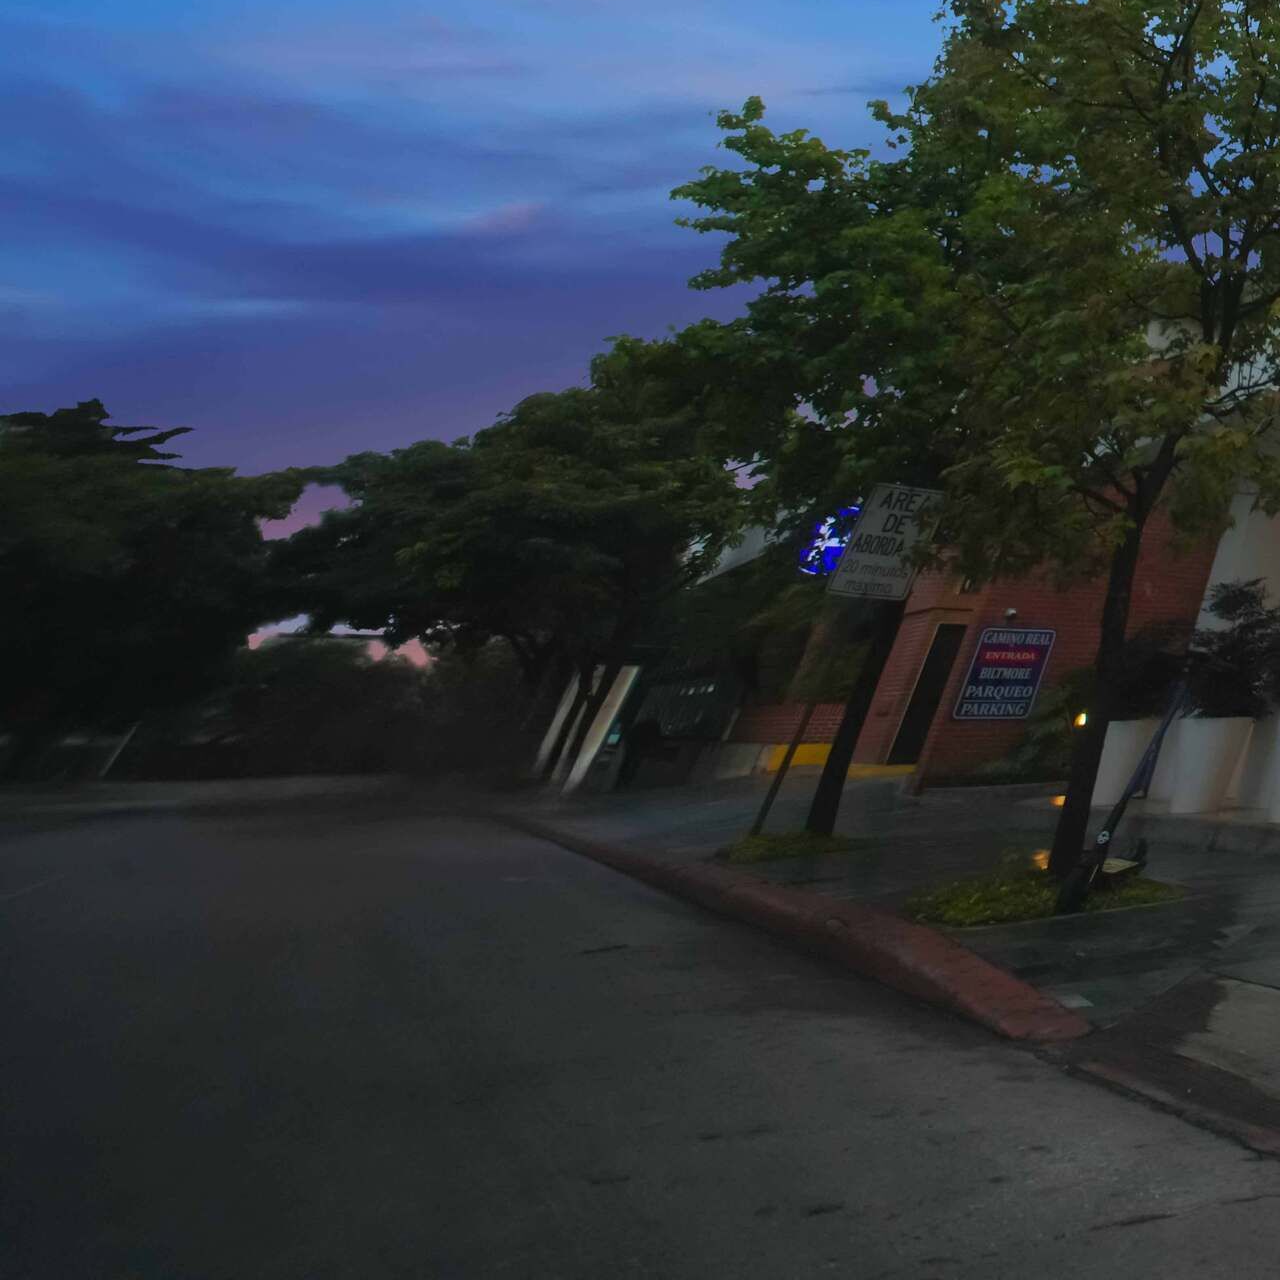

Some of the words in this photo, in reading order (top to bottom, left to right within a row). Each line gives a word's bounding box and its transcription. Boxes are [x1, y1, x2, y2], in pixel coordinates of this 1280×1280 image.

[882, 513, 912, 534] DE
[851, 534, 905, 556] ABORDA
[984, 632, 1024, 644] CAMINO
[1025, 633, 1050, 645] REAL
[985, 651, 1035, 660] ENTRADA
[979, 667, 1032, 679] BILTMORE
[965, 685, 1033, 699] PARQUEO
[960, 703, 1026, 715] PARKING
